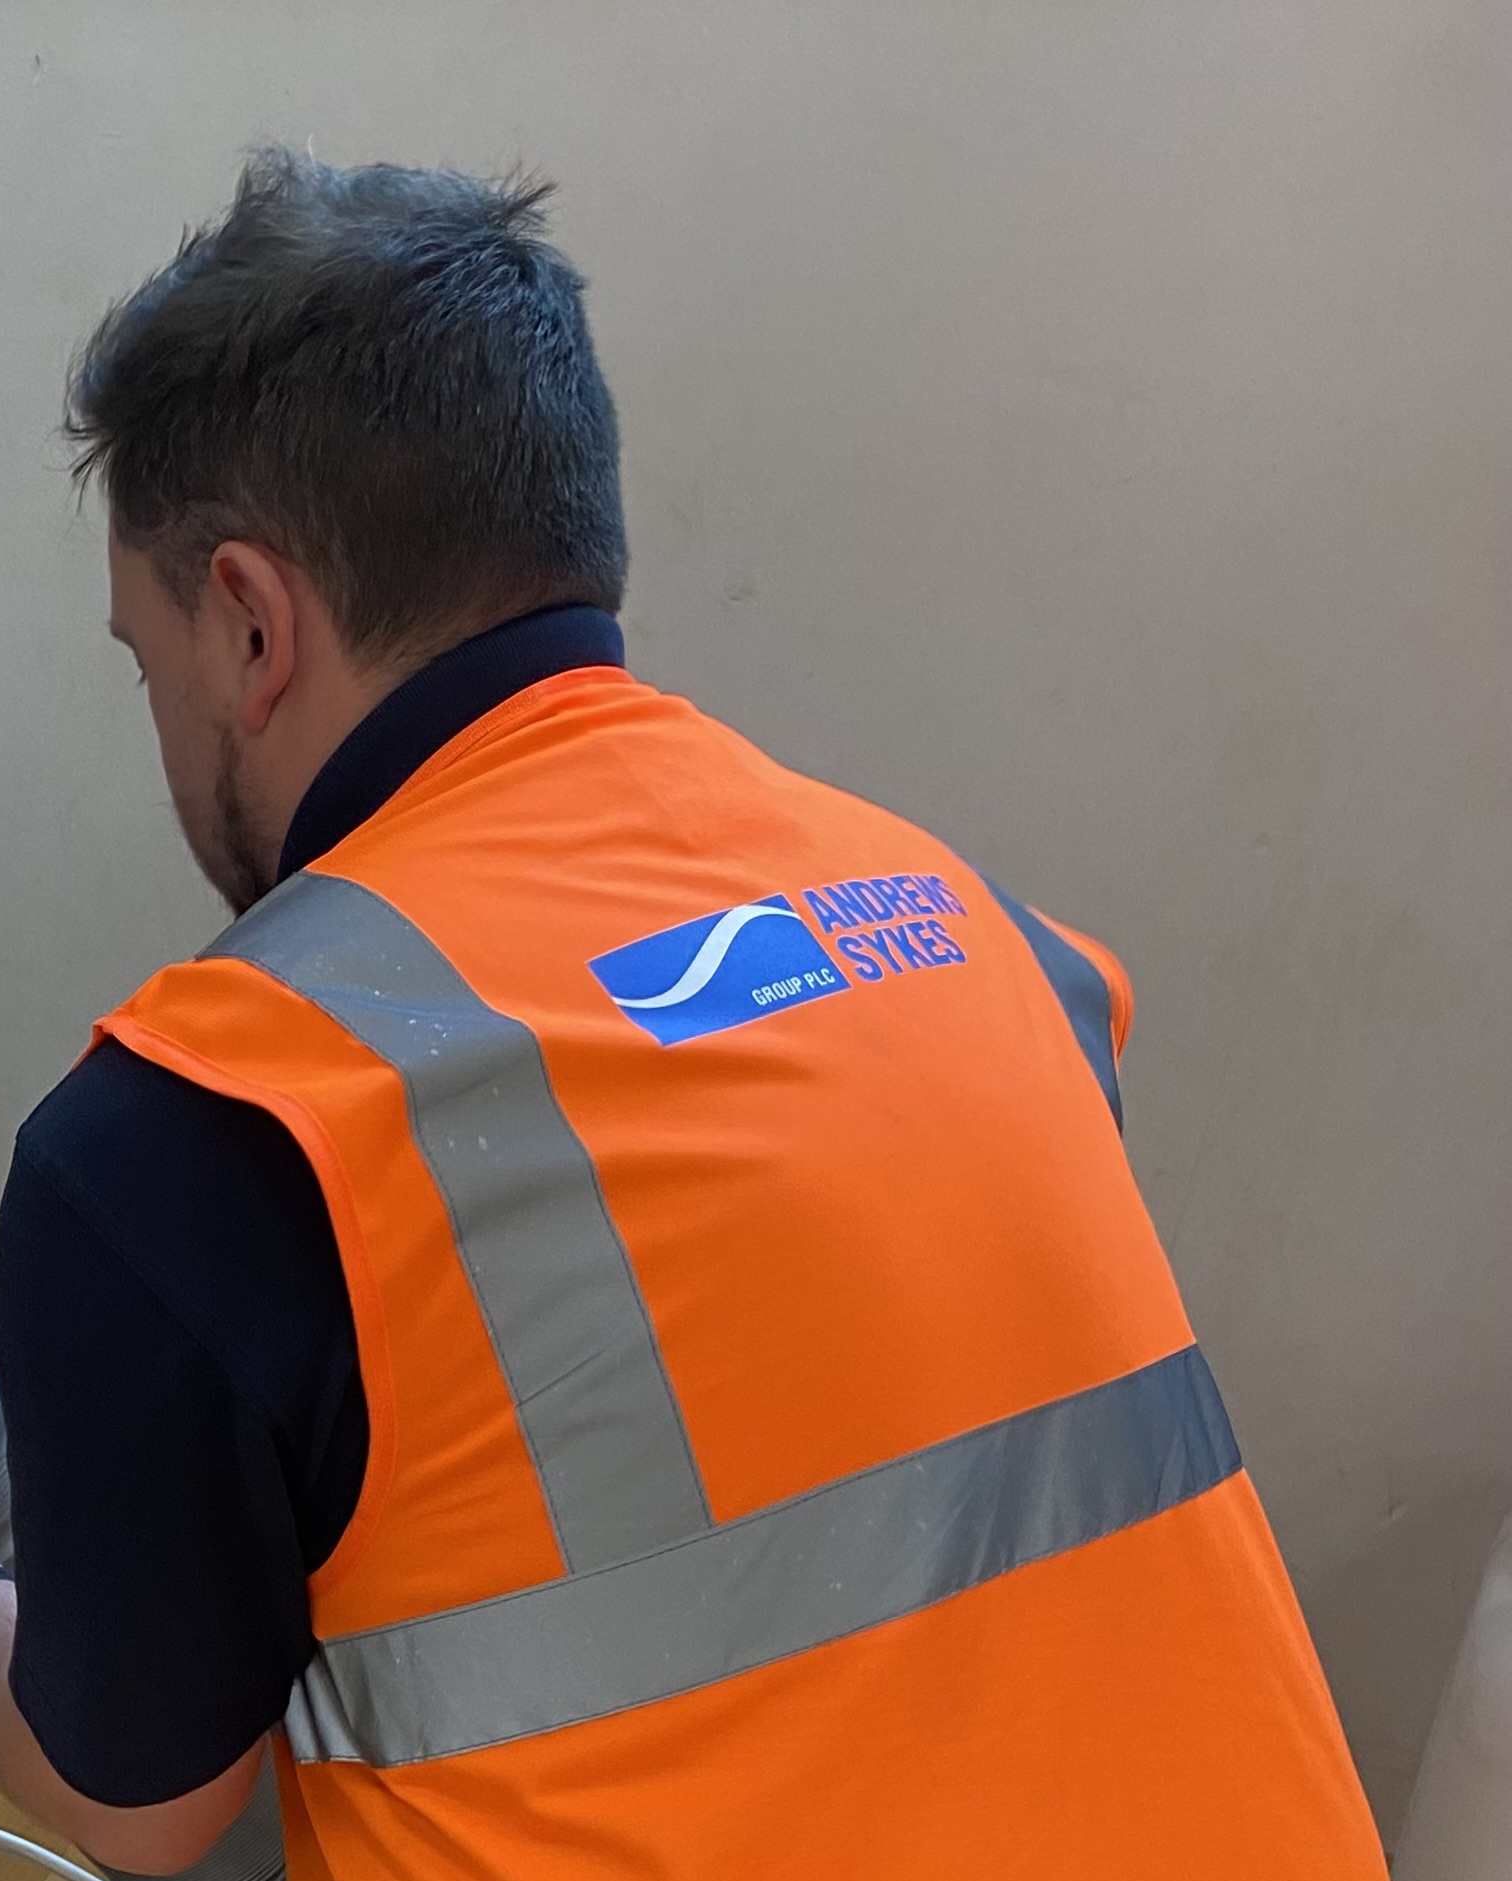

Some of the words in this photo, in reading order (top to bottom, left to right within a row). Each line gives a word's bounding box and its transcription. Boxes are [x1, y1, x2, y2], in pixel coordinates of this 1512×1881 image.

[802, 873, 967, 934] ANDREWS
[837, 919, 966, 982] SYKES
[751, 977, 802, 1006] GROUP
[805, 968, 835, 994] PLC
